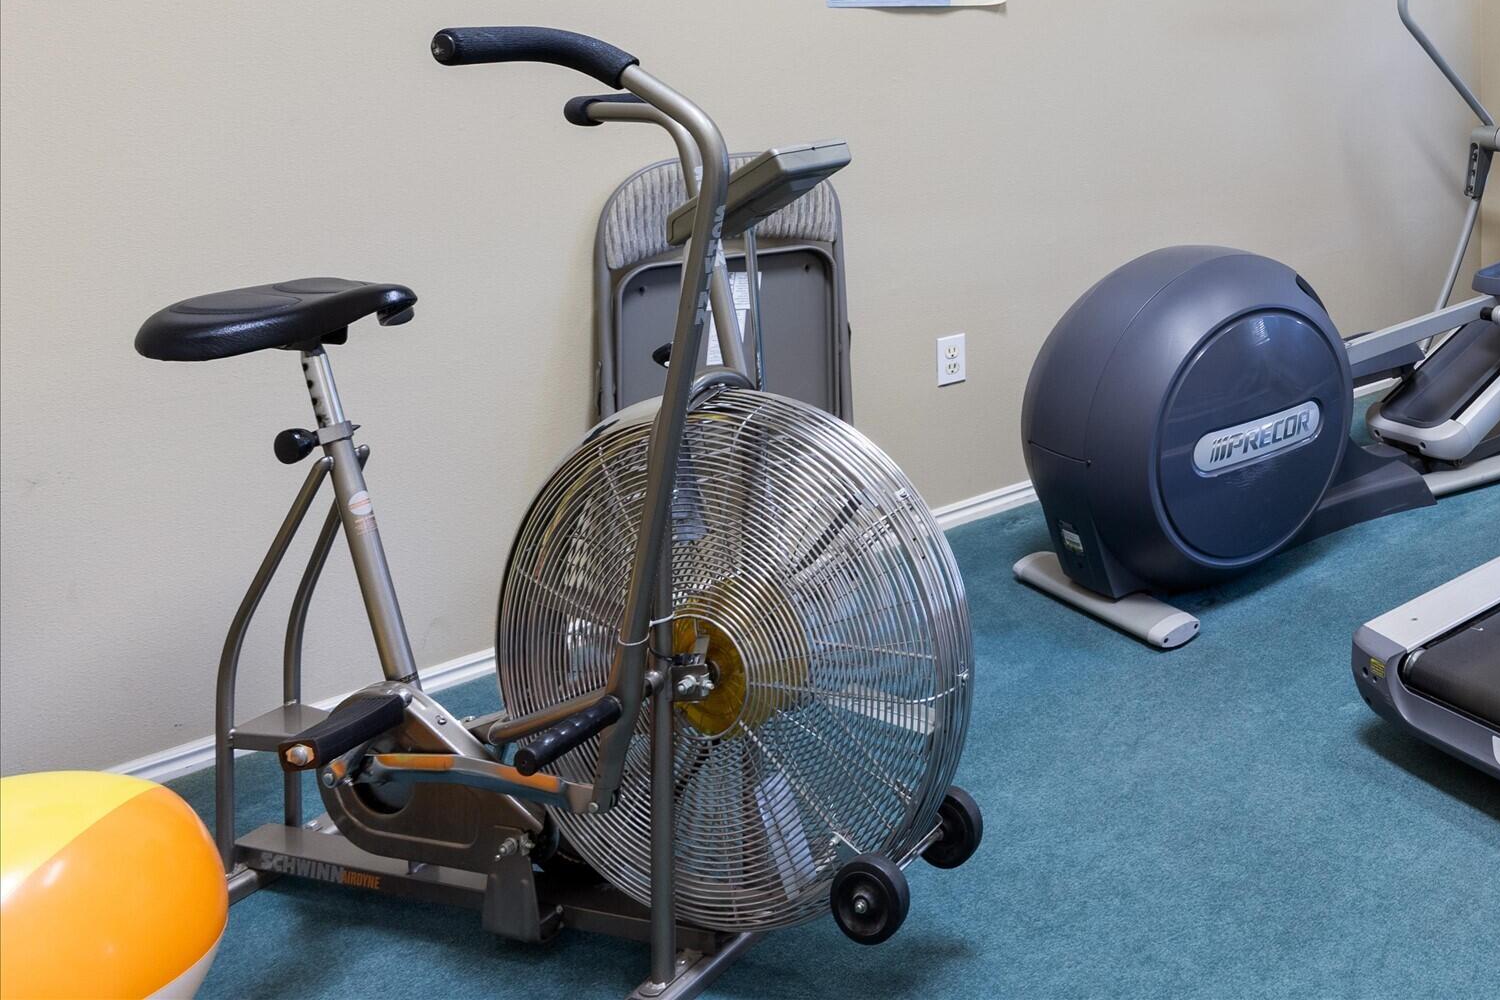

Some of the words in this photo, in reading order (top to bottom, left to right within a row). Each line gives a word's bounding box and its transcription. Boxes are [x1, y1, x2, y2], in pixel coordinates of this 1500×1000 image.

[1226, 410, 1310, 458] PRECOR
[260, 851, 344, 884] SCHWINN
[342, 870, 380, 889] AIRDYNE
